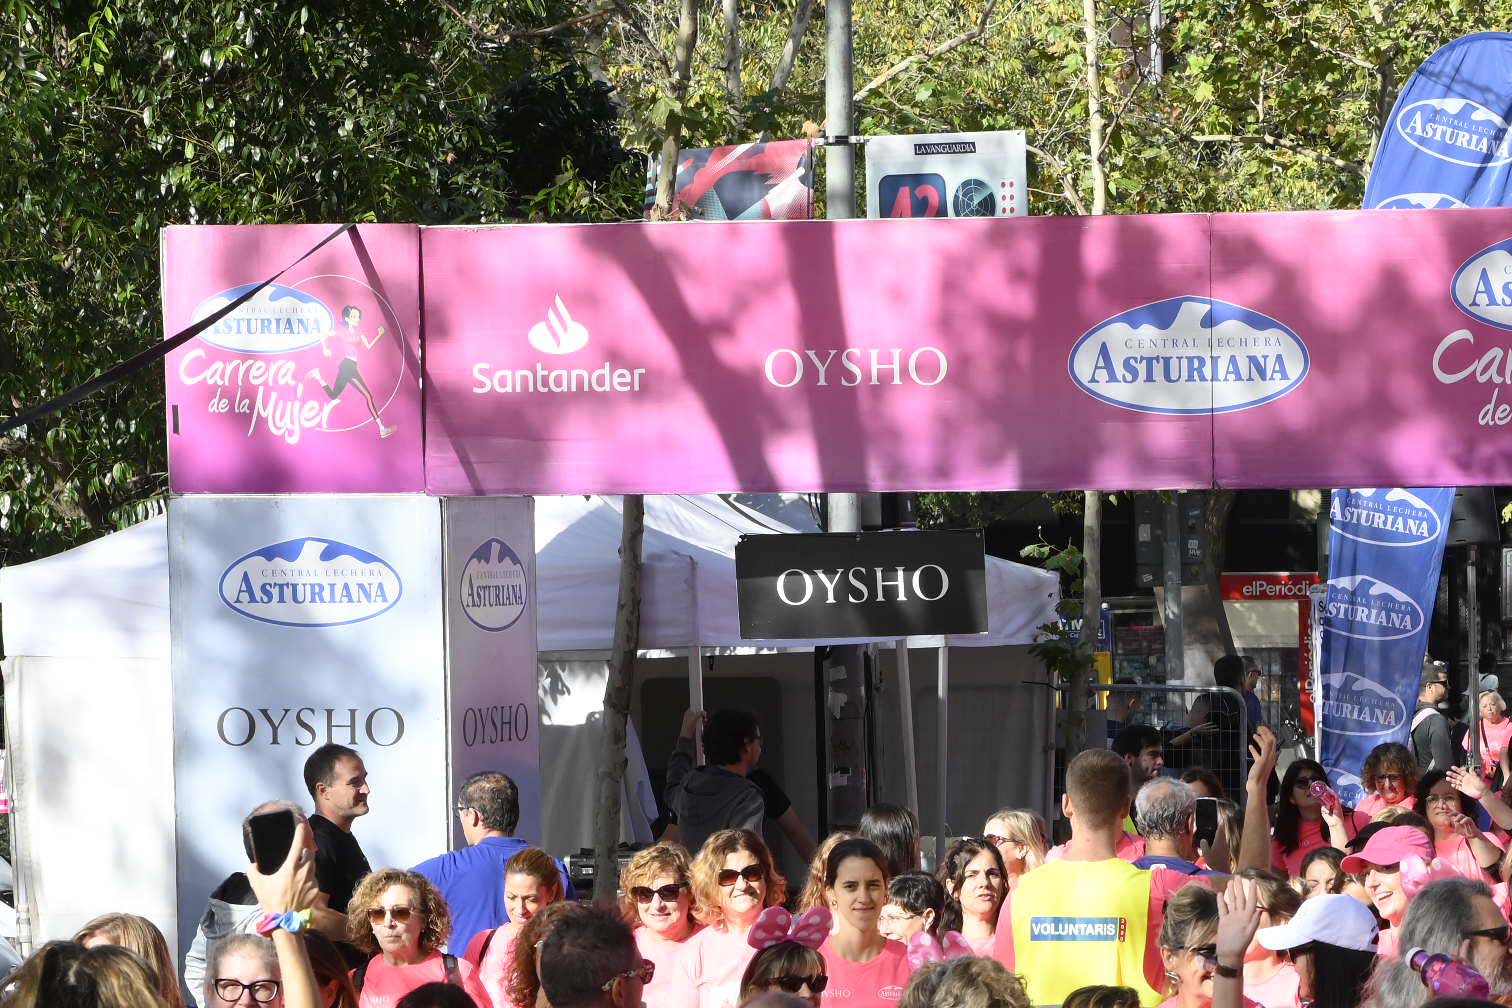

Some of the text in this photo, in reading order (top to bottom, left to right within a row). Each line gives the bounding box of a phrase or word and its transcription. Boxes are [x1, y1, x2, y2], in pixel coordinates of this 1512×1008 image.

[1405, 111, 1510, 158] ASTURIANA
[1125, 336, 1283, 349] CENTRAL LECHERA
[178, 349, 296, 386] Carrera
[472, 362, 646, 393] Santander
[764, 346, 949, 388] OYSHO
[1088, 341, 1290, 384] ASTURIANA
[208, 384, 342, 445] de la Mujer
[1478, 387, 1512, 426] de
[1330, 497, 1429, 537] ASTURIANA
[1387, 504, 1428, 519] LECHERA
[234, 571, 388, 605] ASTURIANA
[262, 568, 383, 577] CENTRAL LECHERA
[776, 564, 949, 605] OYSHO
[1242, 580, 1310, 596] elPeriódi
[466, 576, 524, 609] ASTURIANA
[1327, 602, 1413, 631] STURIANA
[216, 706, 405, 747] OYSHO
[463, 703, 529, 748] OYSHO
[1322, 700, 1396, 726] TURIANA
[1032, 923, 1116, 937] VOLUNTARIS
